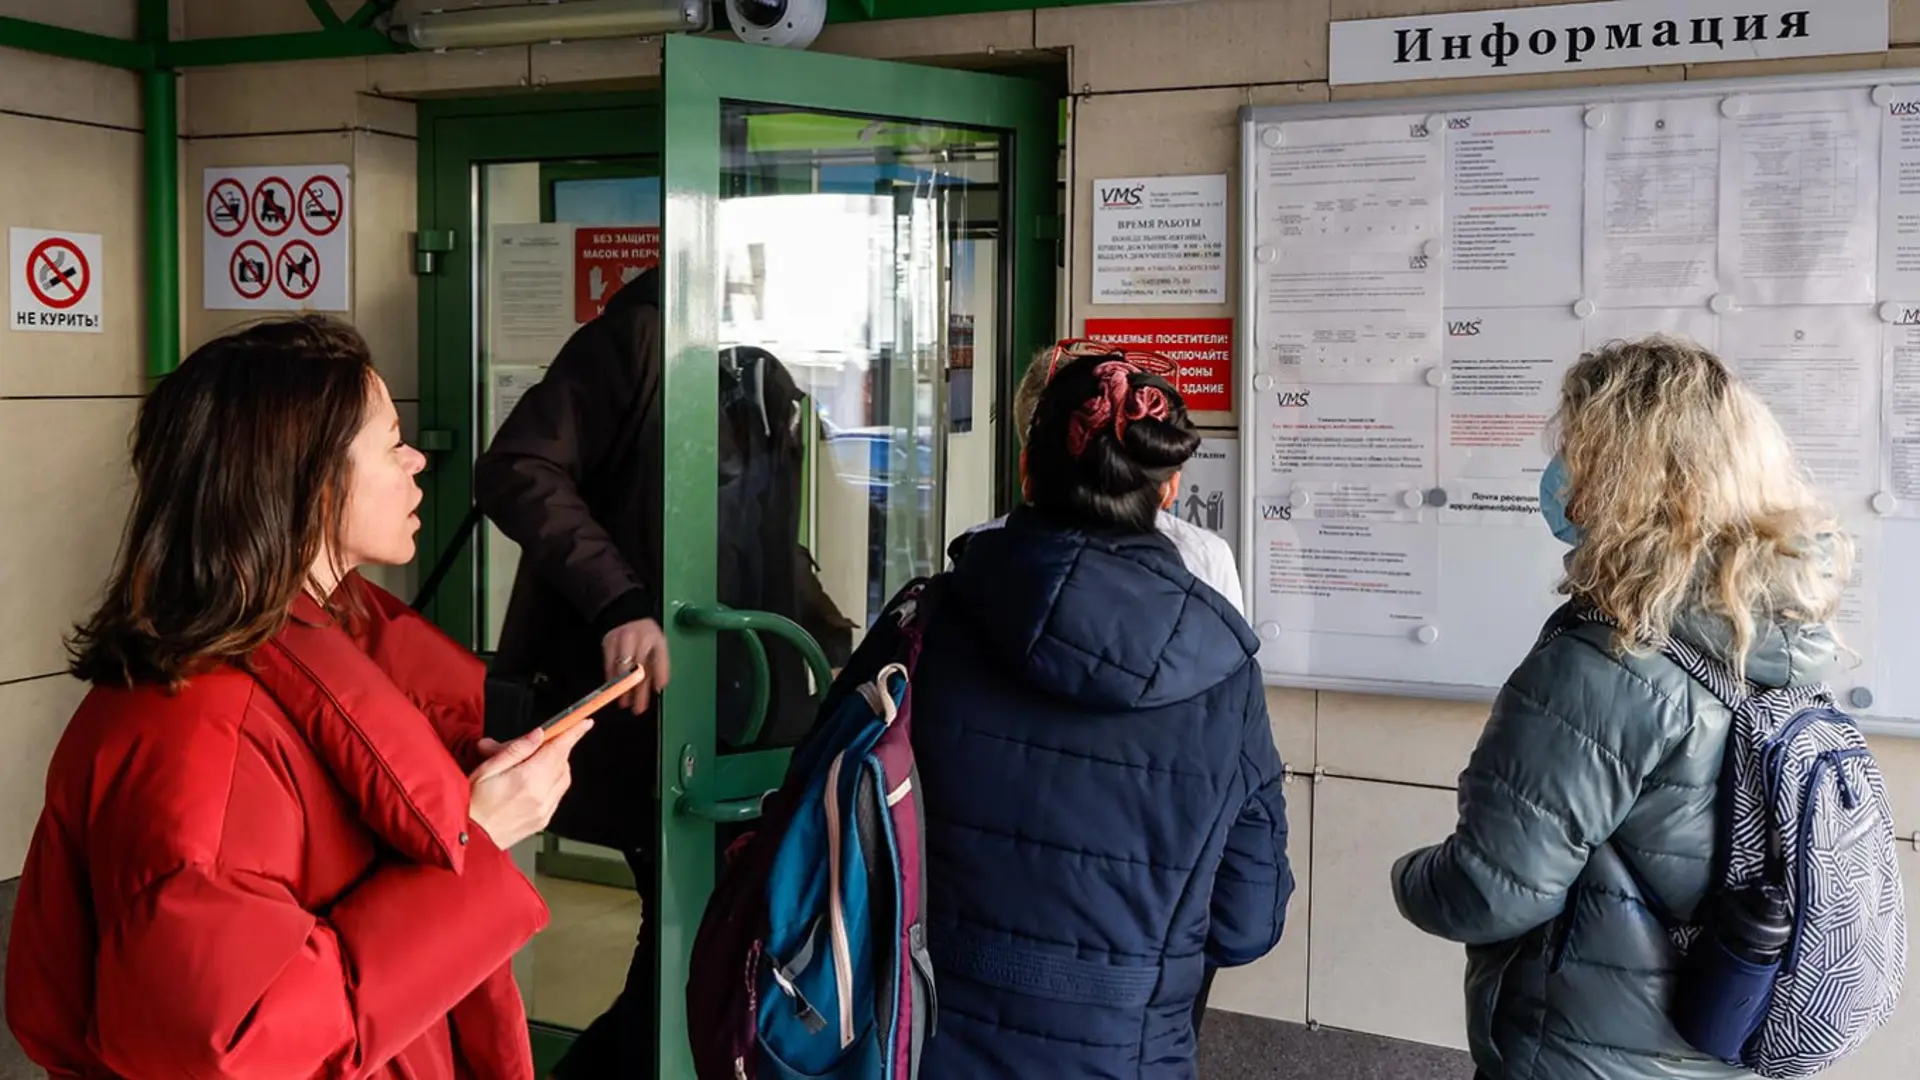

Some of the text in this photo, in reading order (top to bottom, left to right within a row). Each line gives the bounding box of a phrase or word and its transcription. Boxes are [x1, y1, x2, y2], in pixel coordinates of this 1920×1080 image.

[1393, 11, 1811, 67] Информация
[1101, 184, 1145, 206] VMS
[1118, 218, 1202, 229] ВРЕМЯ РАБОТЫ
[593, 233, 613, 244] БЕЗ
[583, 250, 619, 258] МАСОК
[622, 250, 629, 258] И
[17, 312, 98, 327] НЕ КУРИТЬ!
[1447, 317, 1482, 336] VMS
[1156, 334, 1228, 344] ПОСЕТИТЕЛИ:
[1182, 384, 1225, 394] ЗДАНИЕ
[1277, 388, 1311, 408] VMS
[1472, 492, 1498, 501] Почта
[1262, 505, 1291, 521] VMS
